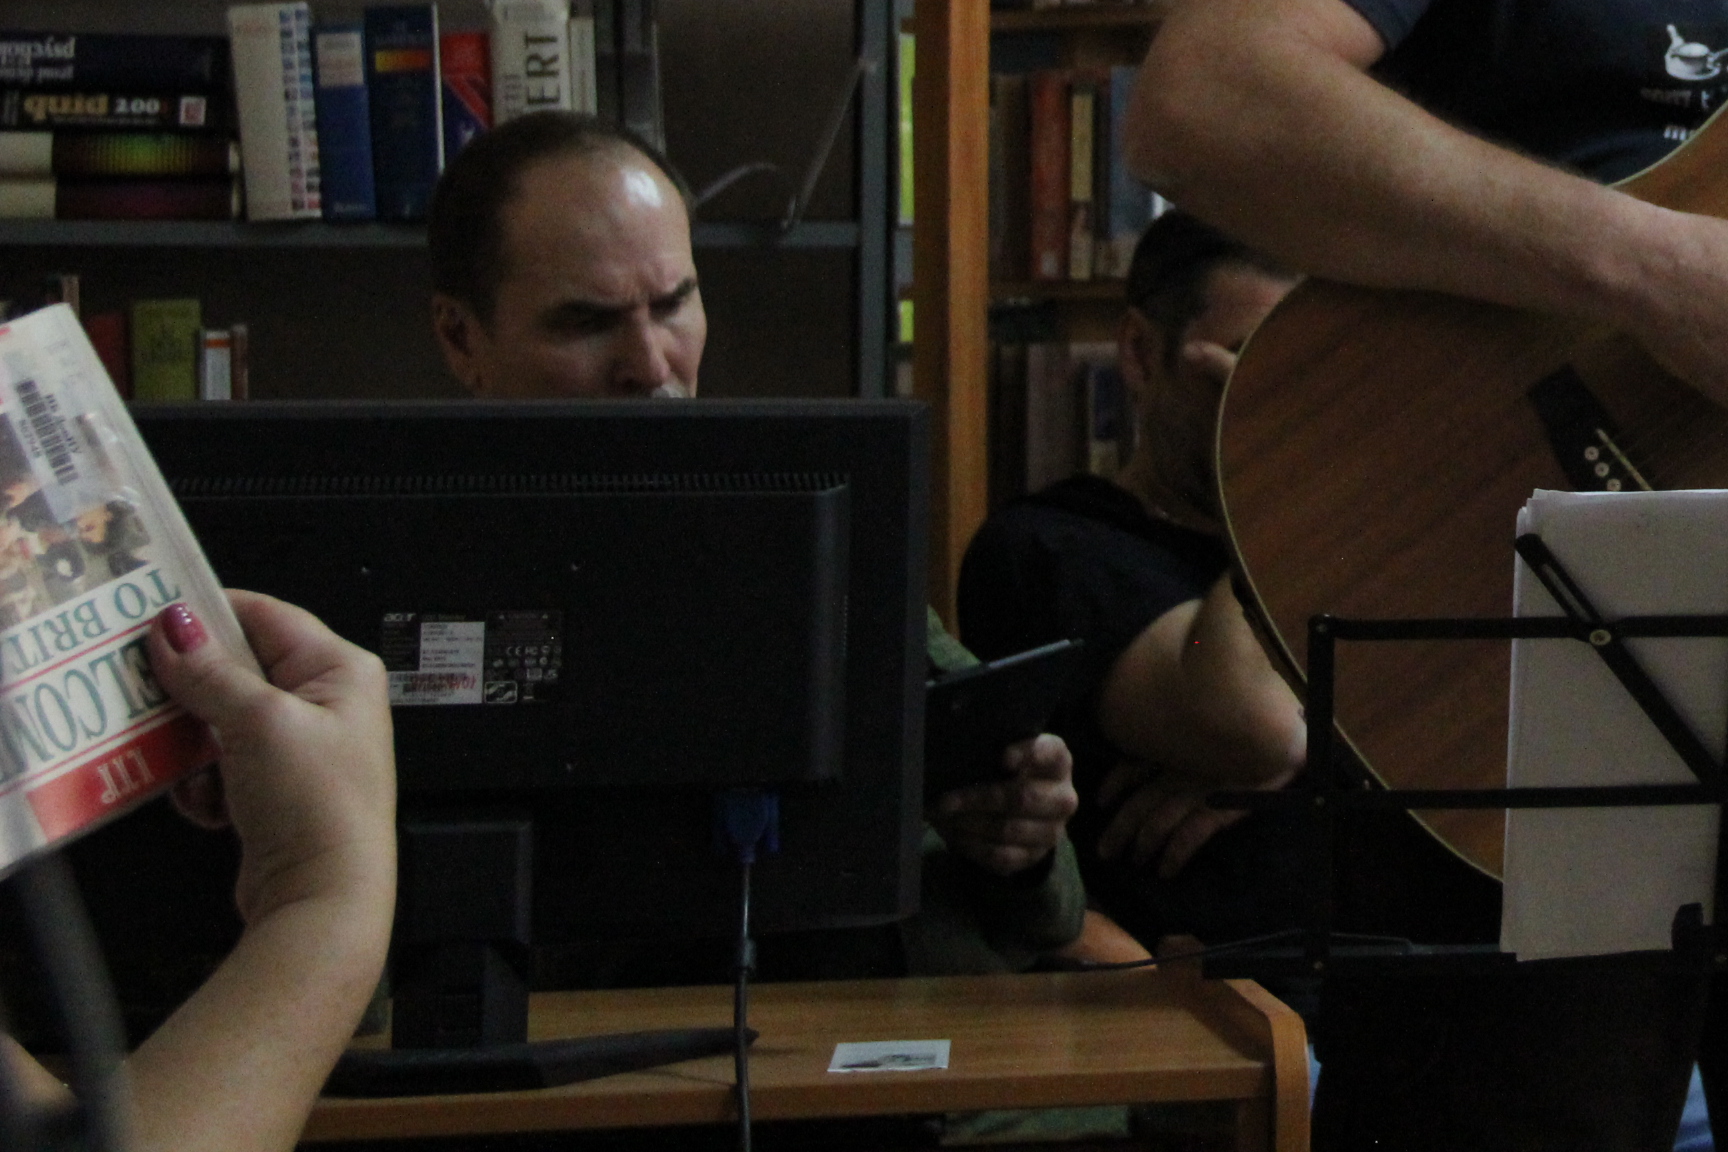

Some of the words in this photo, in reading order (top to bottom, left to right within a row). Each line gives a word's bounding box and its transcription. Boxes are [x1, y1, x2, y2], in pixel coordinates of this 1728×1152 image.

[23, 93, 109, 123] quid
[114, 568, 181, 619] TO
[0, 599, 111, 680] BRIT
[0, 634, 171, 784] ELCOM
